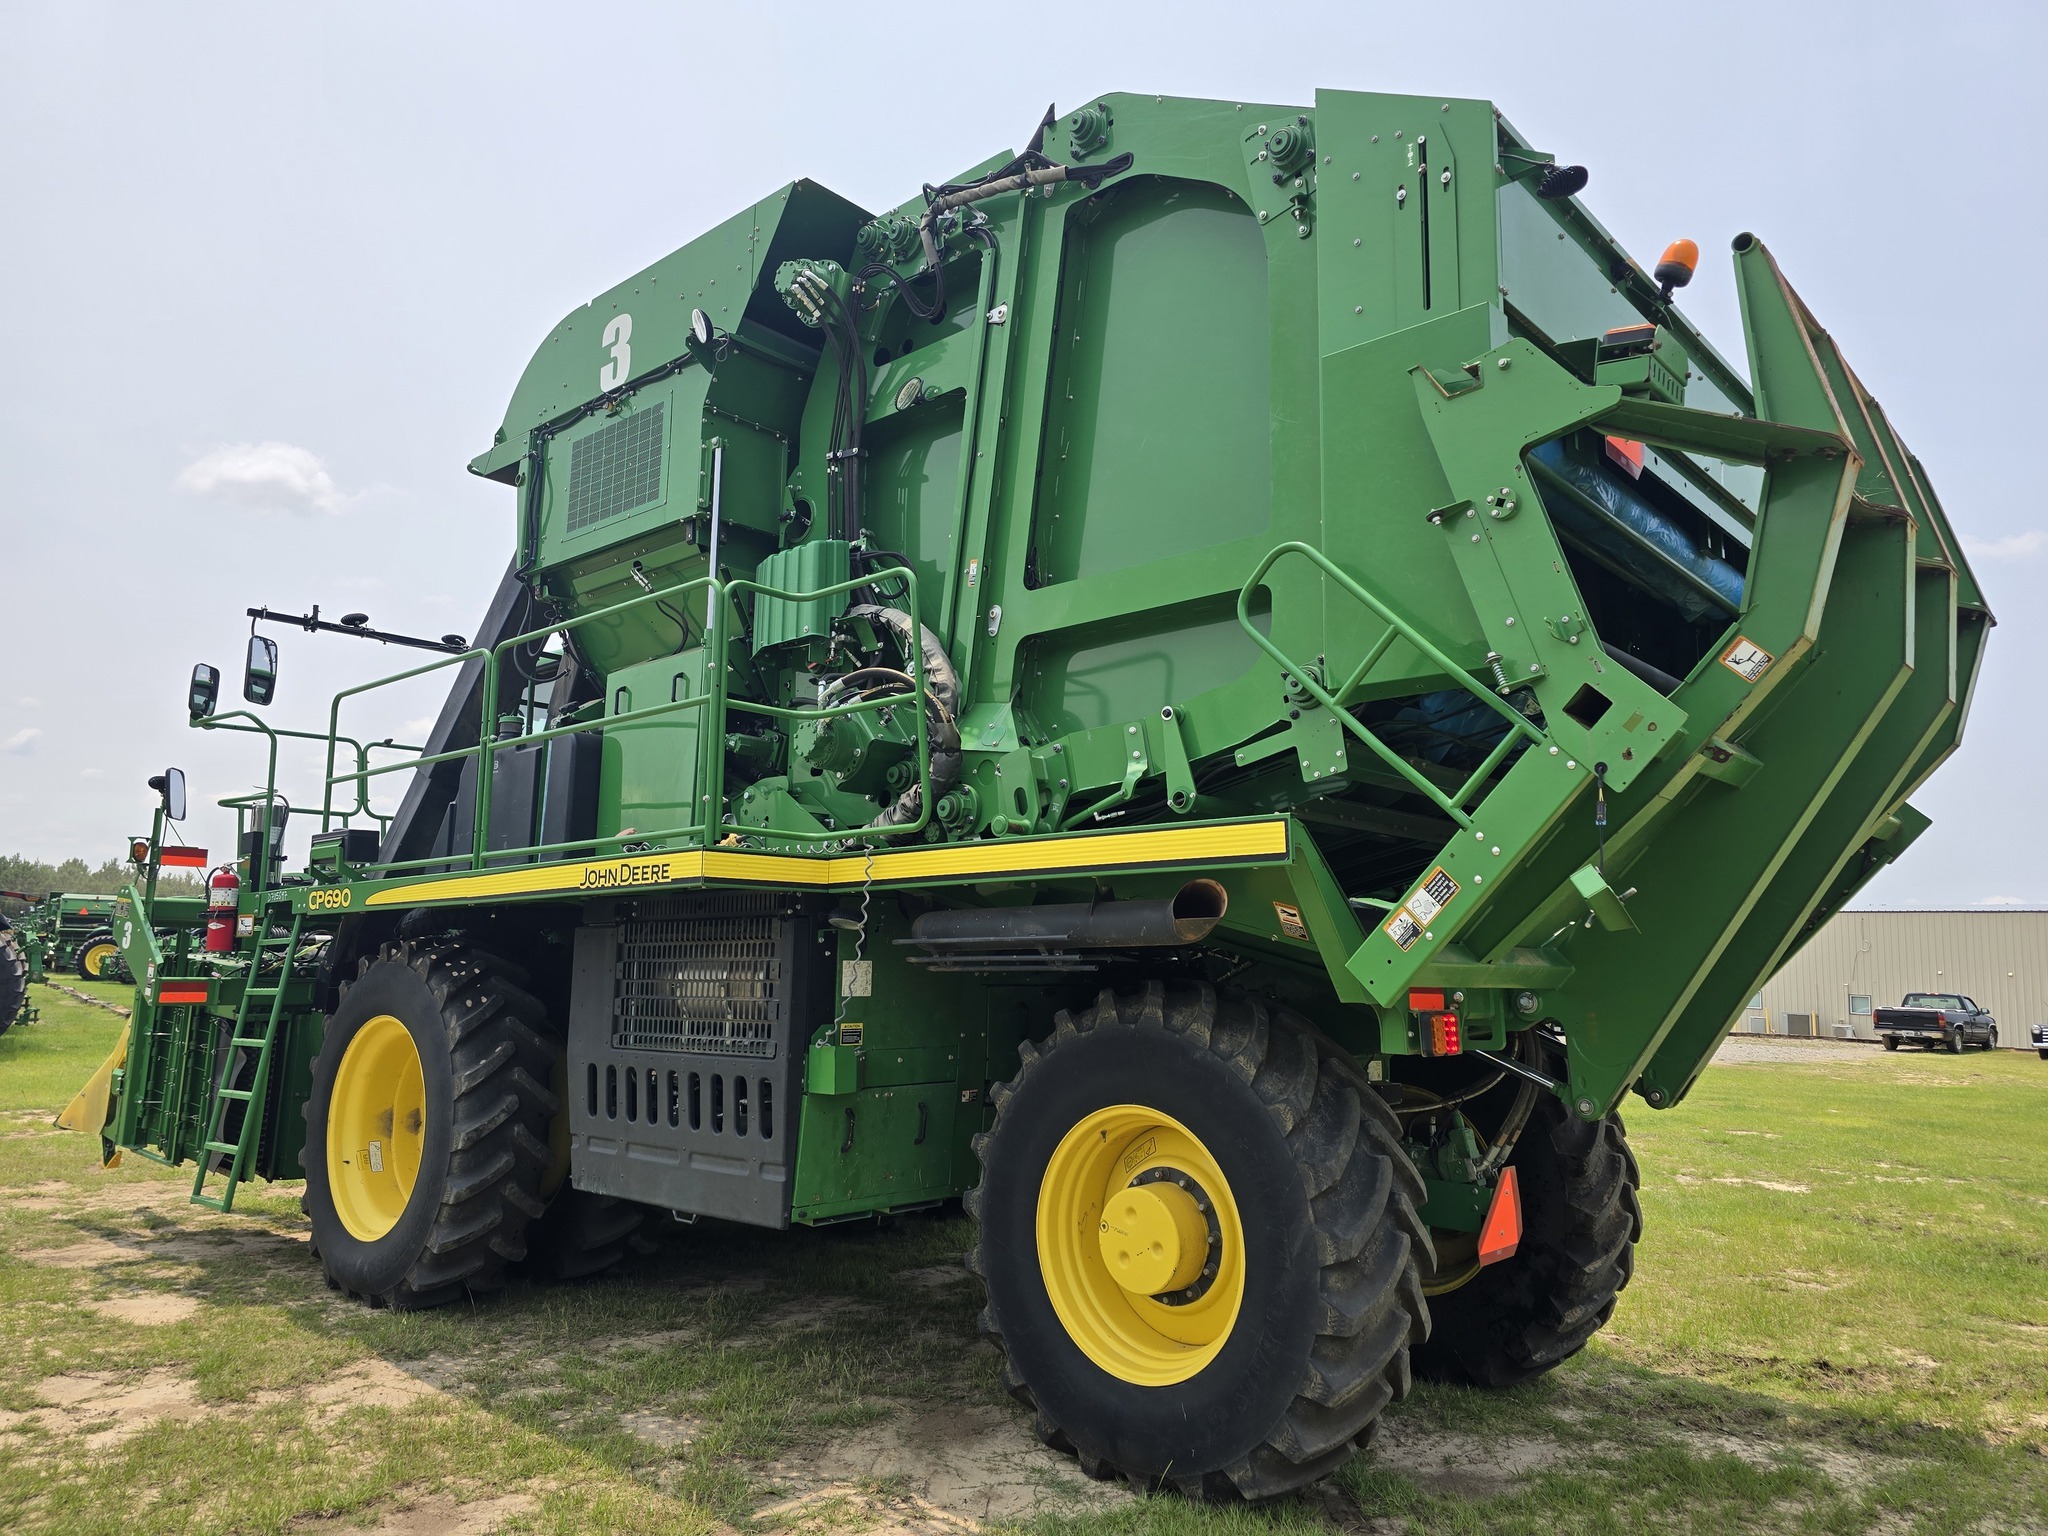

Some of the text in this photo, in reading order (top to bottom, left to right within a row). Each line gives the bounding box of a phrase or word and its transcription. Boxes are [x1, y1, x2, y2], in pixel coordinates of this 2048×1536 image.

[600, 313, 632, 392] 3
[580, 864, 670, 886] JOHN DEERE
[308, 887, 351, 910] CP690
[122, 921, 133, 949] 3
